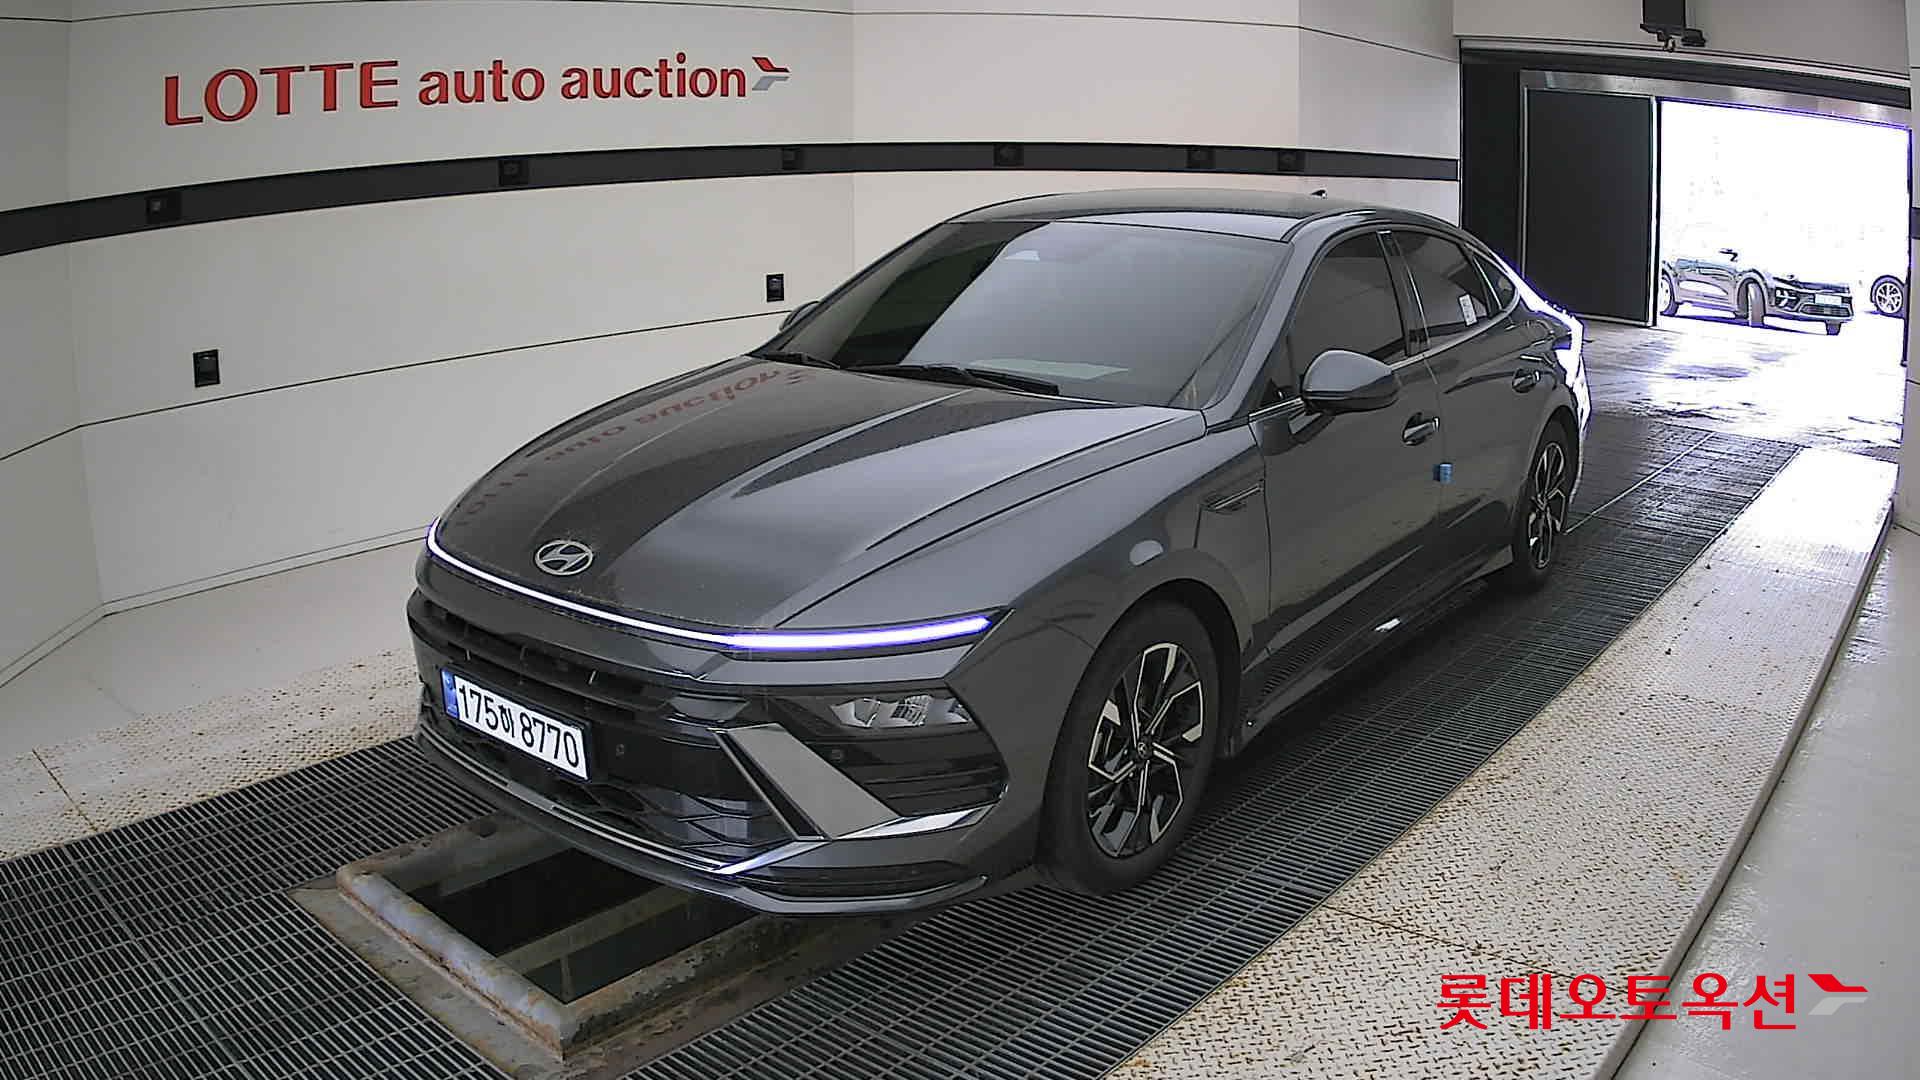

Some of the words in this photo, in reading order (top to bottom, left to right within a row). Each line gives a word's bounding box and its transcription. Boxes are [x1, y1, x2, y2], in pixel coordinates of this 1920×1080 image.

[164, 60, 398, 126] LOTTE
[417, 59, 545, 106] auto
[561, 52, 746, 100] auction
[519, 711, 580, 769] 8770
